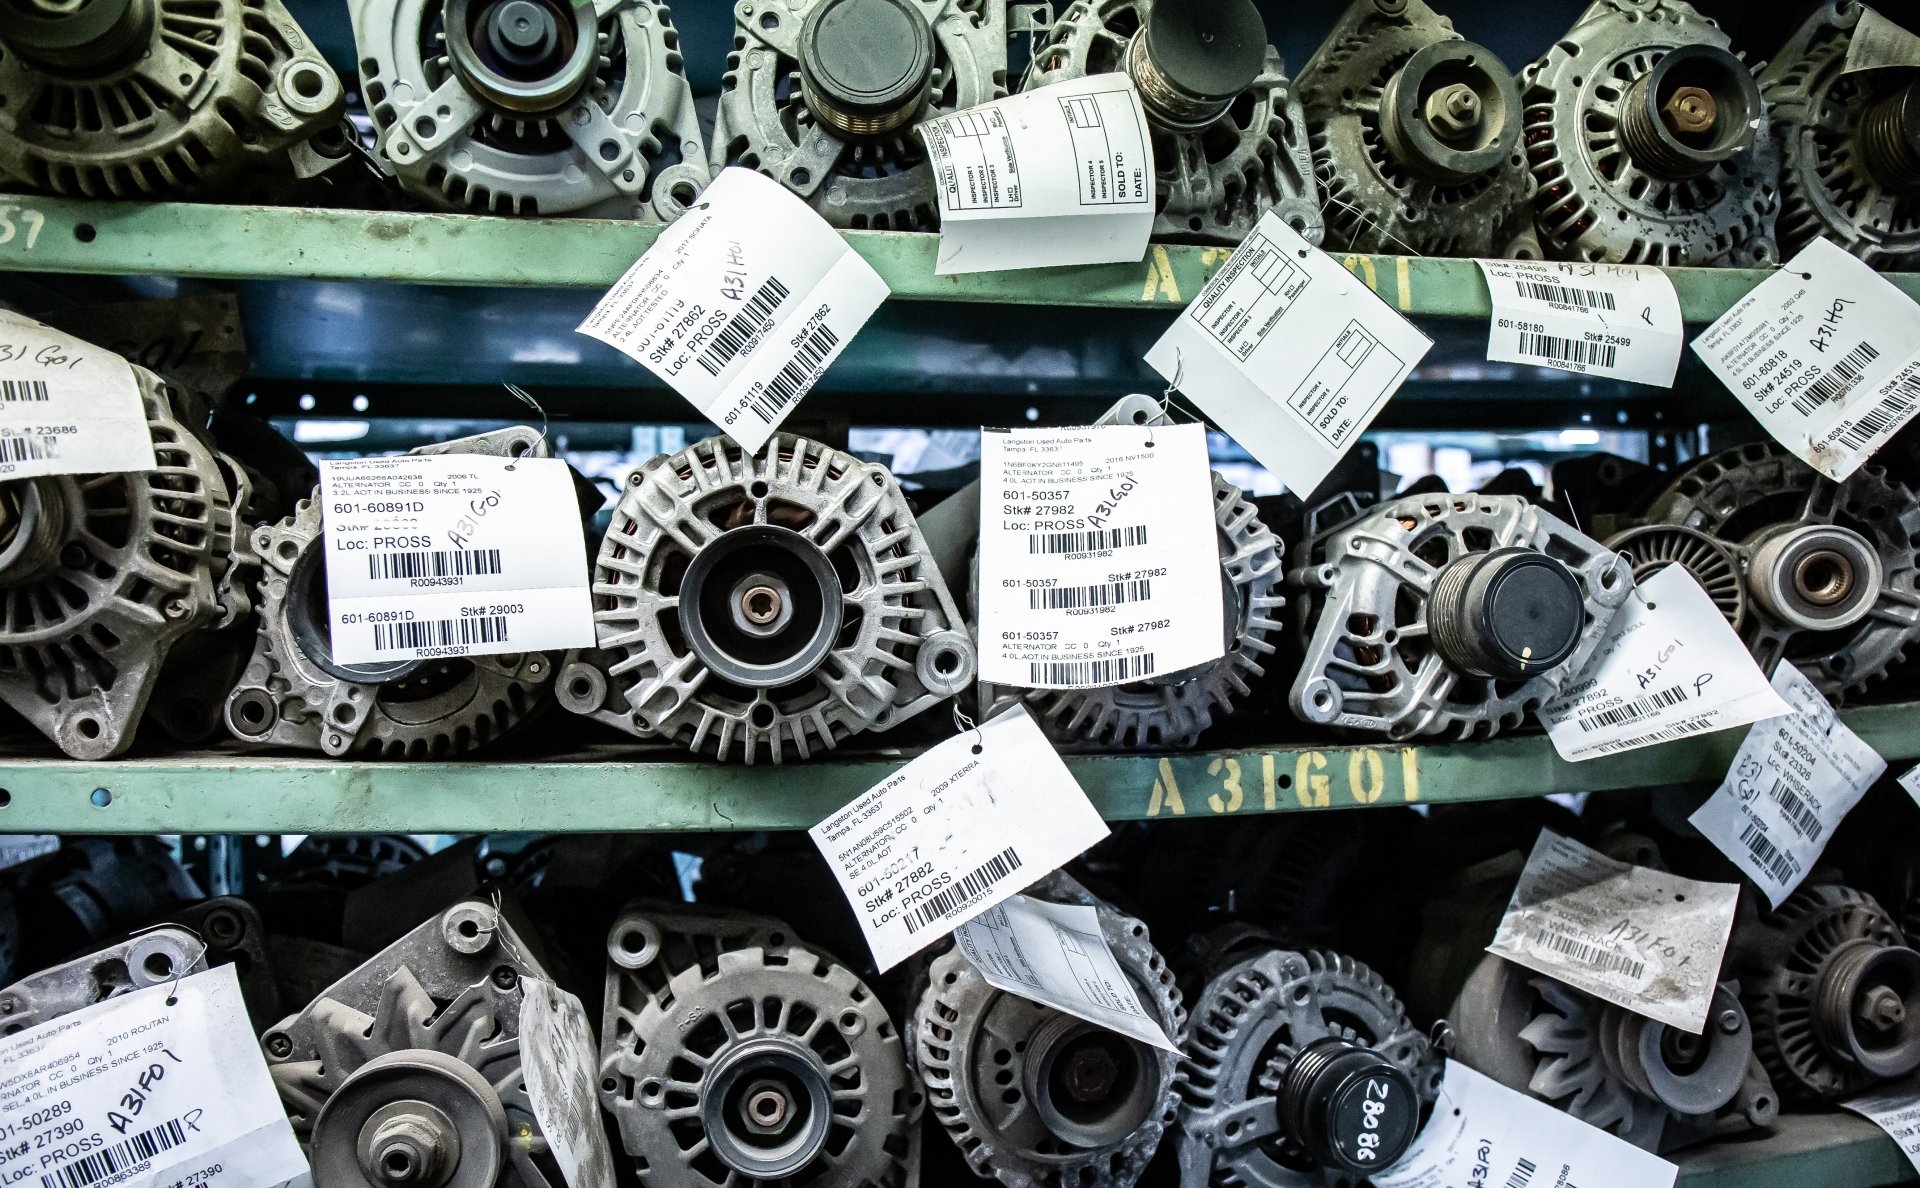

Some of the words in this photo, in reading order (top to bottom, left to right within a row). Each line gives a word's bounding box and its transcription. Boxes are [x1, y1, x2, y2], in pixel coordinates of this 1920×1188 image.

[1118, 171, 1126, 198] SOLD
[1134, 168, 1142, 197] DATE:
[1250, 250, 1266, 268] INITIALS
[1203, 281, 1226, 308] QUALITY
[1225, 247, 1255, 283] INSPECTION
[1490, 269, 1513, 277] Loc:
[1517, 272, 1560, 283] PROSS
[1781, 298, 1795, 310] 2002
[1794, 289, 1805, 299] Q45
[791, 328, 809, 348] Stk#
[807, 304, 831, 330] 27862
[1211, 304, 1233, 329] INSPECTOR
[1219, 311, 1241, 336] INSPECTOR
[1498, 319, 1544, 333] 601-58180
[1773, 325, 1791, 340] SINCE
[1790, 314, 1804, 326] 1925
[650, 338, 674, 363] Stk#
[672, 305, 705, 339] 27862
[665, 352, 691, 376] Loc:
[687, 310, 727, 352] PROSS
[738, 319, 775, 357] R00917450
[1584, 332, 1603, 342] Stk#
[1605, 335, 1630, 346] 25499
[1743, 350, 1787, 389] 601-60818
[1754, 382, 1774, 401] Stk#
[1773, 360, 1802, 385] 24519
[1879, 380, 1898, 395] Stk#
[1896, 362, 1920, 381] 24519
[1765, 396, 1787, 414] Loc:
[1784, 365, 1821, 397] PROSS
[725, 382, 767, 425] 601-61119
[1320, 408, 1337, 429] SOLD
[1336, 396, 1348, 408] TO:
[36, 426, 77, 435] 23686
[1332, 419, 1351, 441] DATE:
[1813, 421, 1852, 455] 601-60818
[335, 502, 423, 513] 601-60891D
[1003, 491, 1069, 500] 601-50357
[1004, 505, 1031, 514] Stk#
[1036, 505, 1074, 515] 27982
[1004, 521, 1029, 530] Loc:
[1035, 519, 1084, 530] PROSS
[338, 539, 368, 550] Loc:
[374, 536, 431, 548] PROSS
[1065, 550, 1113, 560] R00931982
[411, 577, 462, 587] R00943931
[1003, 579, 1057, 587] 601-50357
[1108, 572, 1131, 582] Stk#
[1135, 568, 1166, 579] 27982
[342, 611, 414, 624] 601-60891D
[461, 606, 486, 616] Stk#
[490, 604, 524, 615] 29003
[1066, 606, 1115, 616] R00931982
[1002, 632, 1058, 640] 601-50357
[1111, 625, 1134, 635] Stk#
[1138, 619, 1170, 632] 27982
[416, 646, 470, 658] R00943931
[1097, 649, 1122, 658] SINCE
[1572, 689, 1608, 707] 27892
[1578, 697, 1623, 721] PROSS
[949, 761, 979, 784] XTERRA
[1789, 757, 1811, 781] 23326
[1146, 747, 1418, 816] A31G01
[1783, 767, 1822, 812] WHSERACK
[821, 811, 853, 834] Langston
[853, 797, 871, 812] Used
[872, 788, 887, 800] Auto
[887, 775, 905, 789] Parts
[826, 826, 852, 842] Tampa,
[852, 818, 863, 826] FL
[862, 801, 882, 819] 33637
[866, 888, 893, 912] Stk#
[895, 862, 934, 893] 27882
[873, 907, 900, 928] Loc:
[902, 872, 951, 909] PROSS
[945, 888, 993, 921] R00920015
[1549, 920, 1623, 952] WHSERACK
[37, 1030, 56, 1041] Auto
[107, 1032, 128, 1046] 2010
[131, 1016, 169, 1036] ROUTAN
[59, 1064, 108, 1089] BUSINESS
[111, 1051, 140, 1067] SINCE
[143, 1041, 163, 1053] 1925
[34, 1118, 83, 1148] 27390
[2, 1164, 37, 1185] Loc:
[40, 1133, 103, 1169] PROSS
[185, 1163, 223, 1186] 27390
